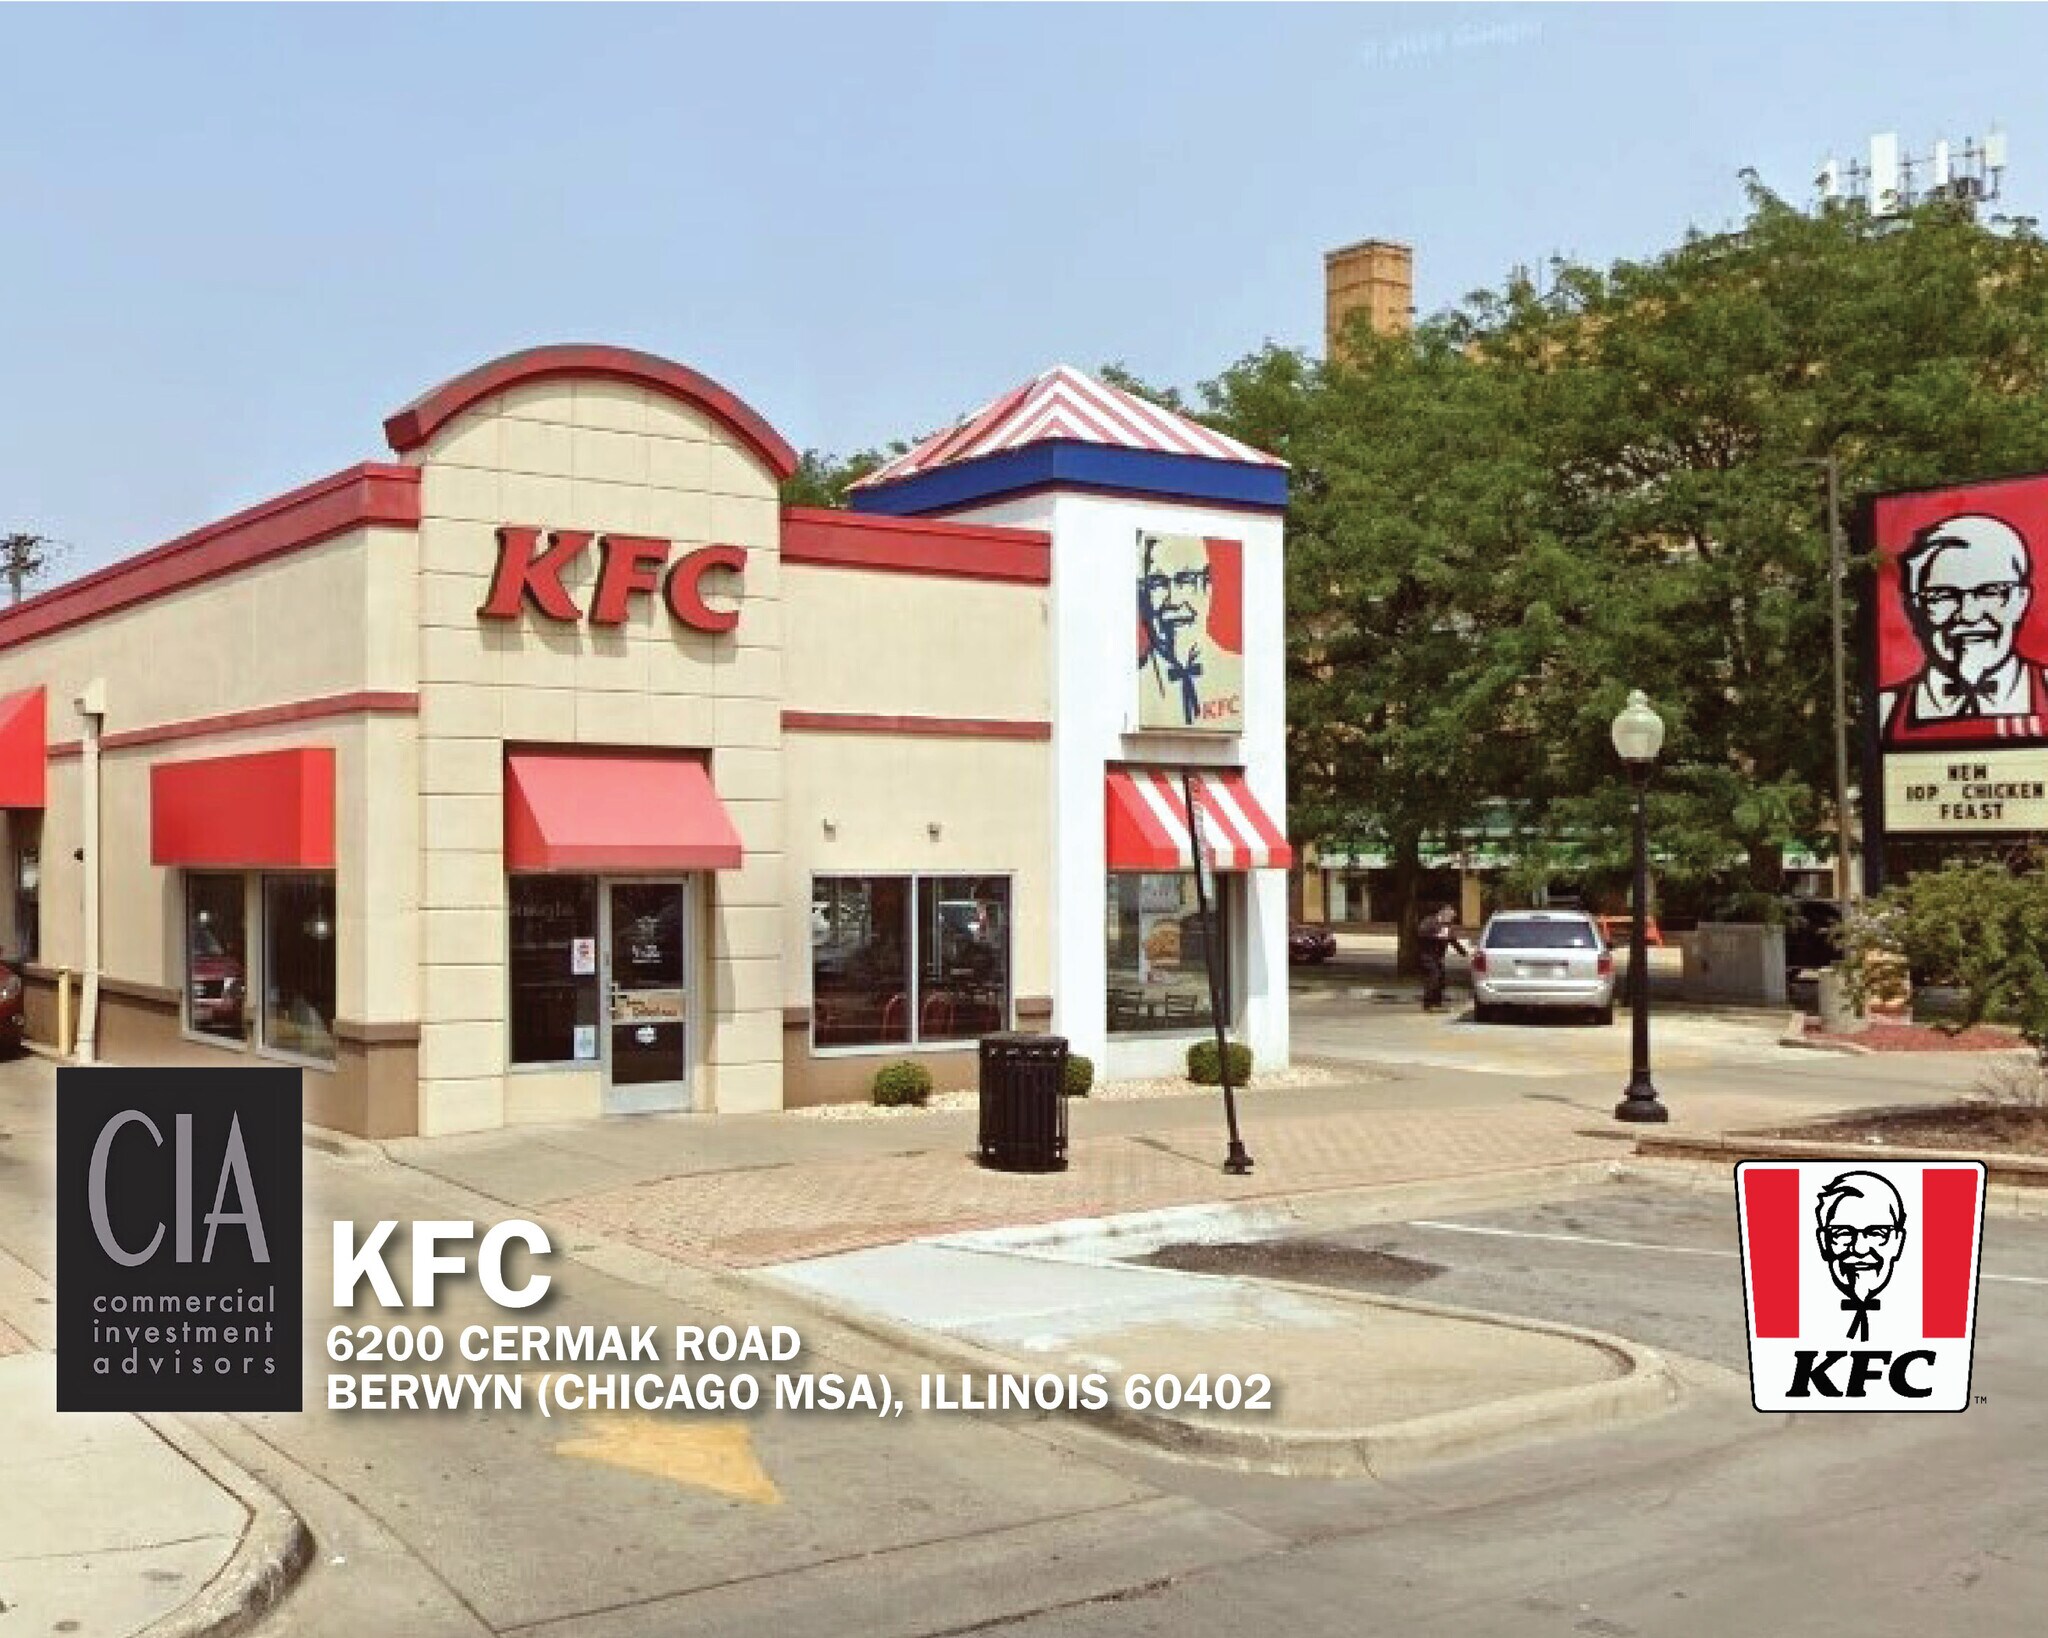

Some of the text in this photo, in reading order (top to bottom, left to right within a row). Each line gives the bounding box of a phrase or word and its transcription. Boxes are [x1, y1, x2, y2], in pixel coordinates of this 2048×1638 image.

[477, 526, 747, 633] KFC
[1962, 781, 2044, 799] CHICKEN
[1939, 803, 2004, 819] FEAST
